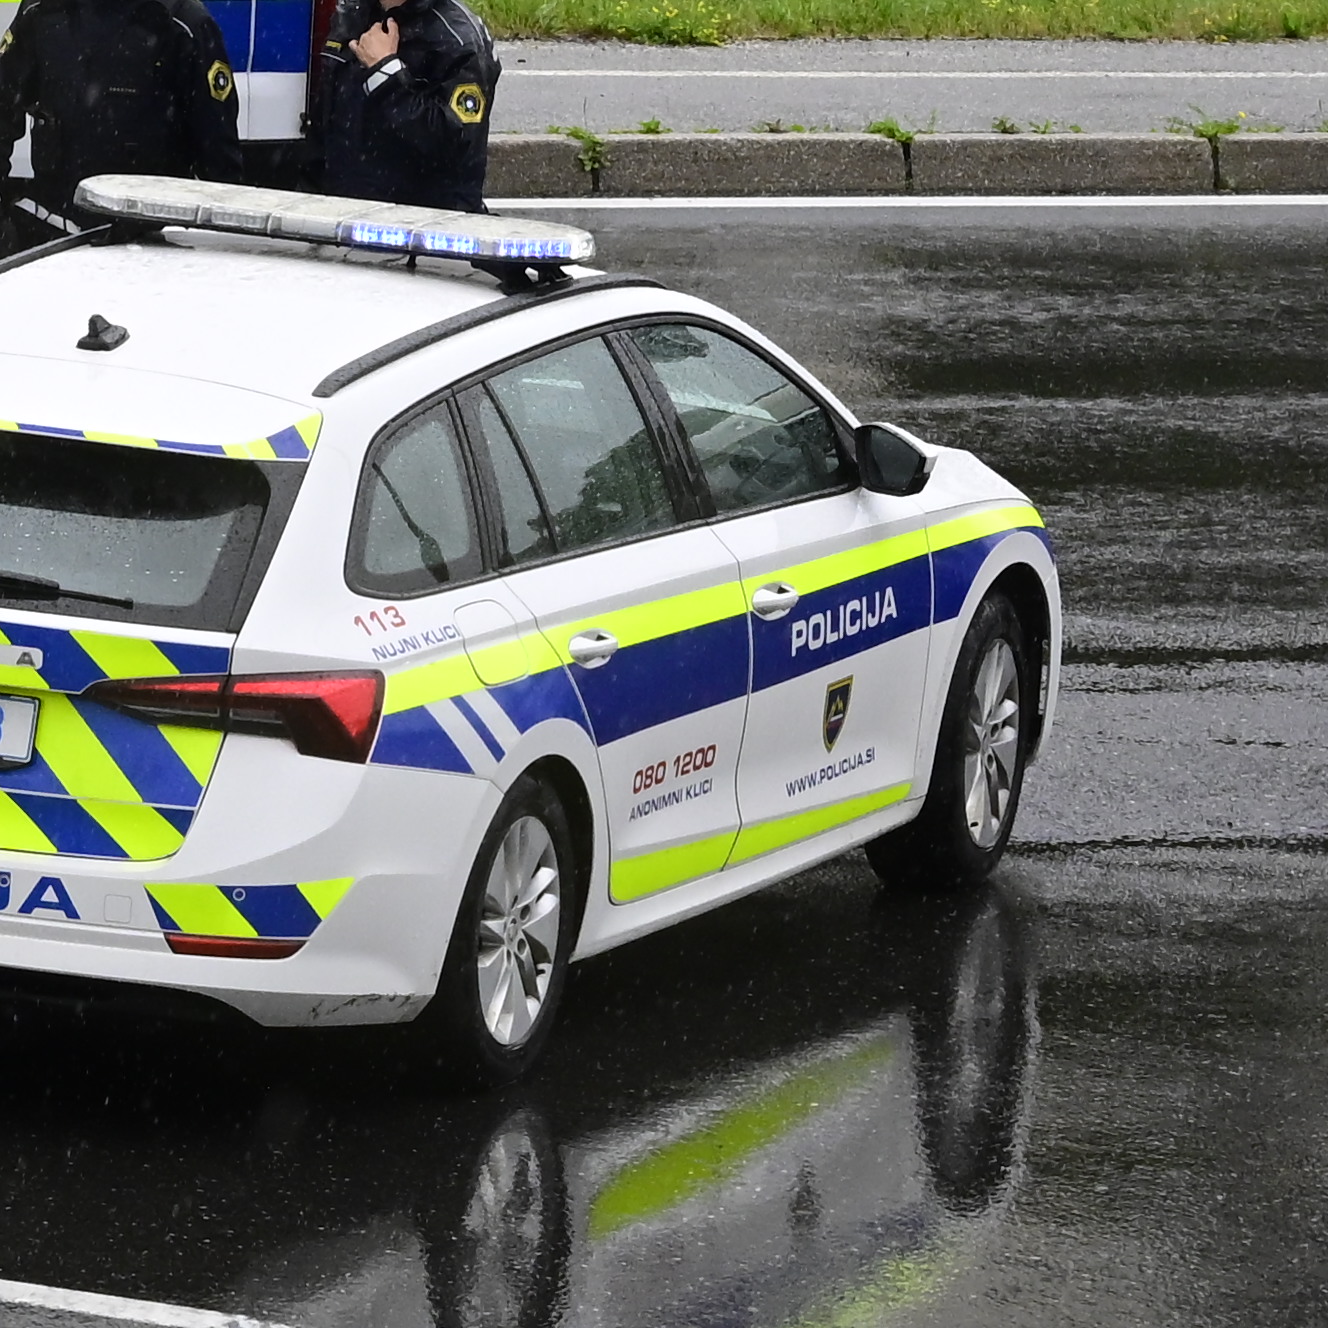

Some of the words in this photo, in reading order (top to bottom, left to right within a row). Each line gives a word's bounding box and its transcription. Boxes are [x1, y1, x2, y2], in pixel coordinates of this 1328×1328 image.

[354, 605, 406, 637] 113
[371, 635, 422, 661] NUJNI
[421, 623, 461, 646] KLICI
[791, 586, 897, 657] POLICIJA
[633, 760, 667, 795] 080
[673, 743, 717, 778] 1200
[786, 746, 875, 798] WWW.POLICIJA.SI
[628, 788, 684, 822] ANONIMNI
[684, 778, 713, 801] KLICI
